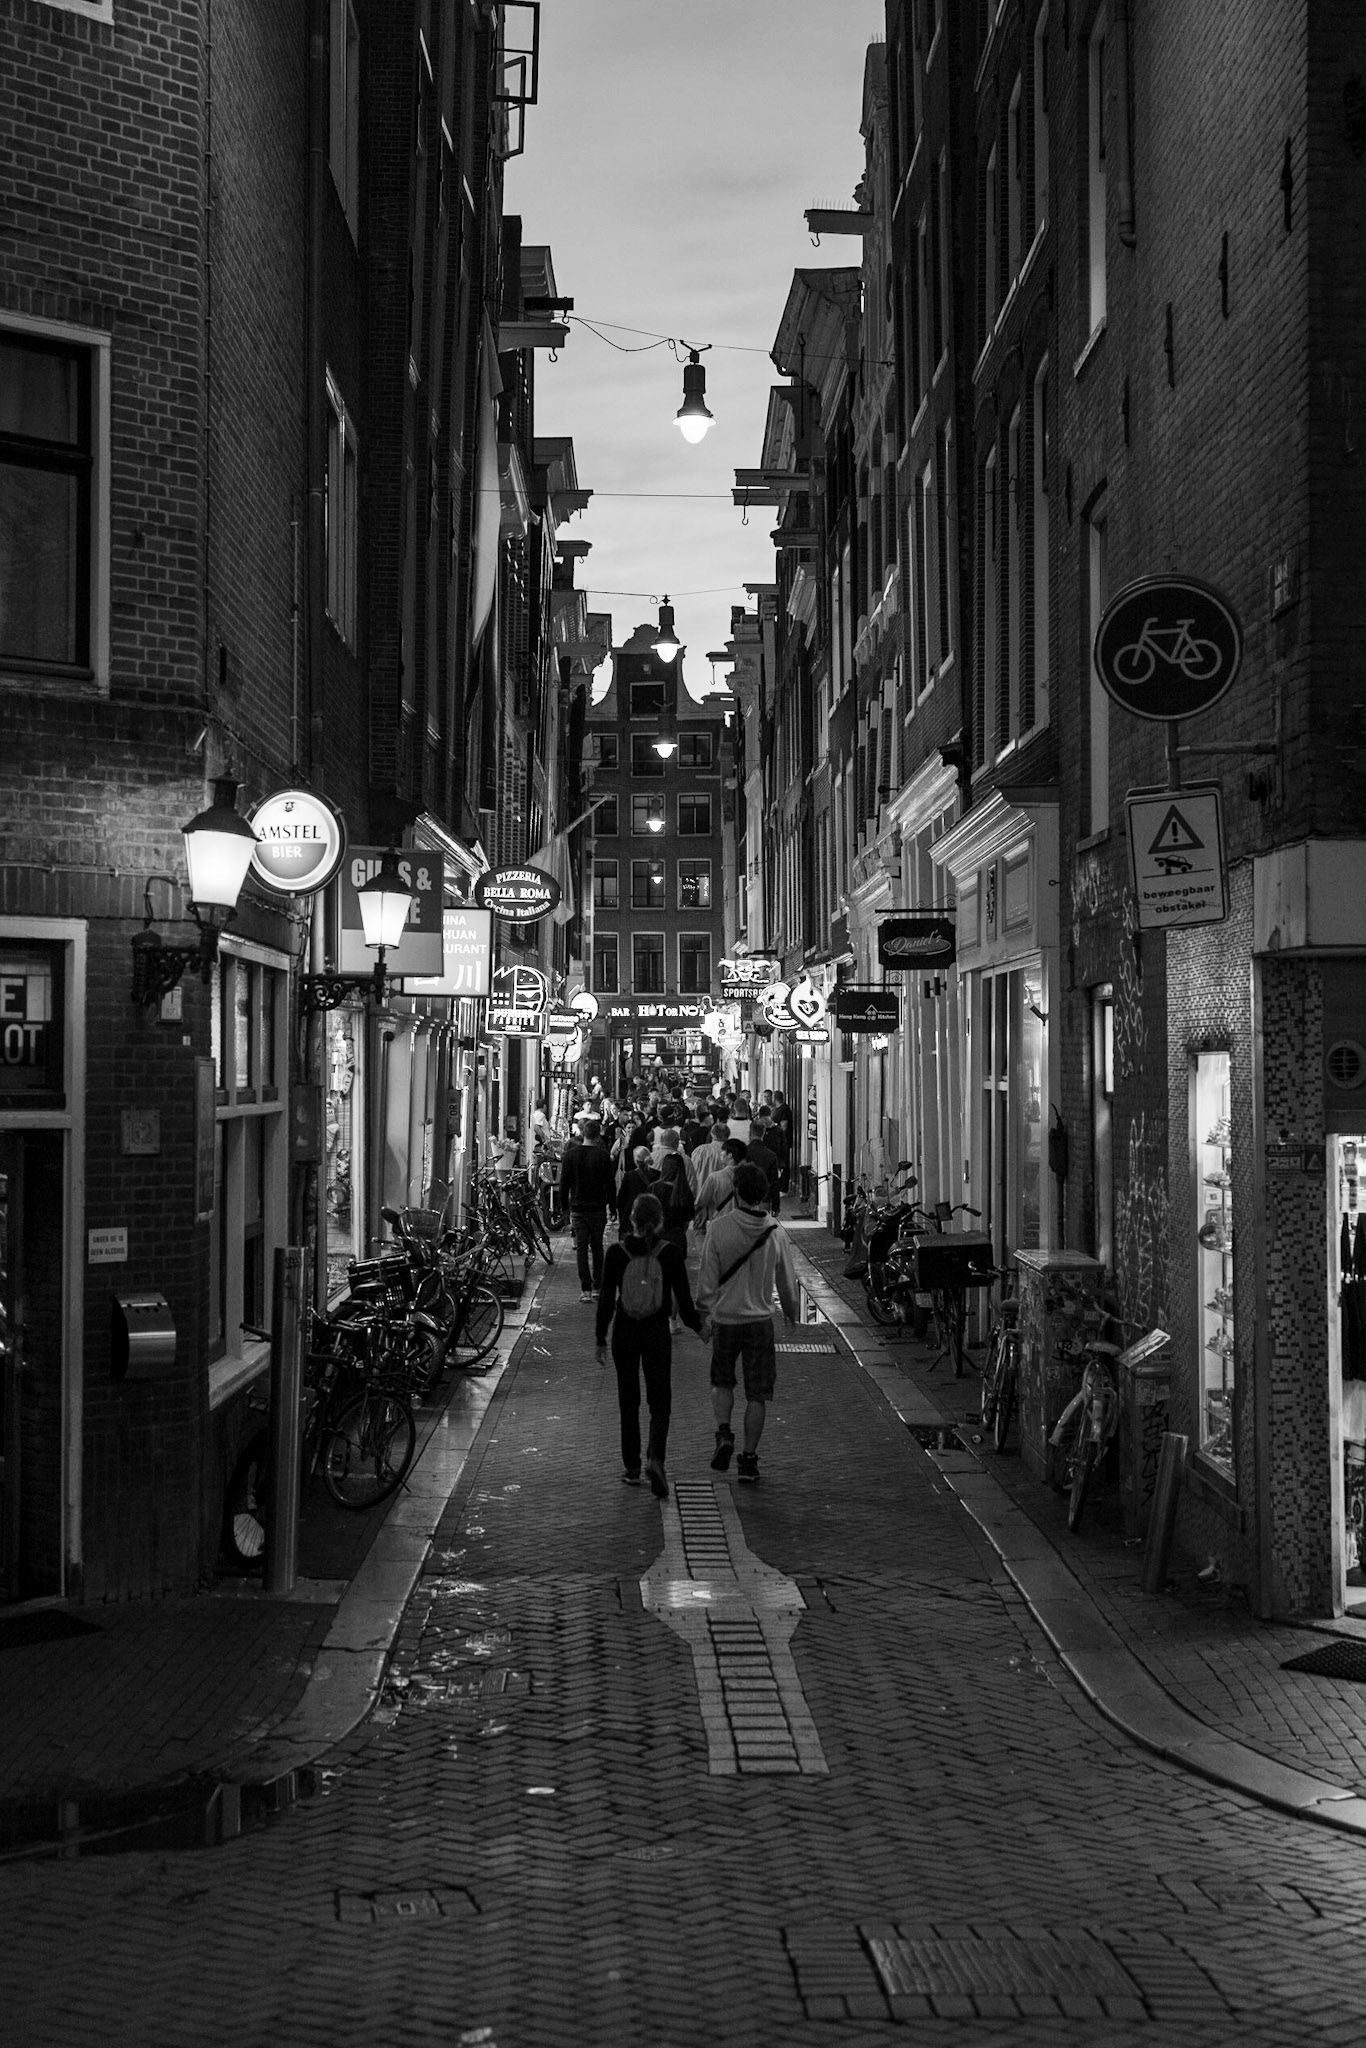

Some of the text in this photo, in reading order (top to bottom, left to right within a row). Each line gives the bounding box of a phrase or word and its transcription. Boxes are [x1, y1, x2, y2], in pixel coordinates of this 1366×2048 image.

[259, 825, 321, 839] AMSTEL
[272, 845, 303, 858] BIER
[416, 867, 433, 891] &
[495, 870, 541, 885] PIZZERIA
[483, 887, 552, 899] BELLA ROMA
[1143, 884, 1216, 900] beweegbaar
[516, 901, 551, 917] Italiana
[1155, 900, 1206, 914] obstakel
[611, 1008, 630, 1016] BAR
[0, 1023, 43, 1065] OT
[1268, 1145, 1301, 1153] ALARM
